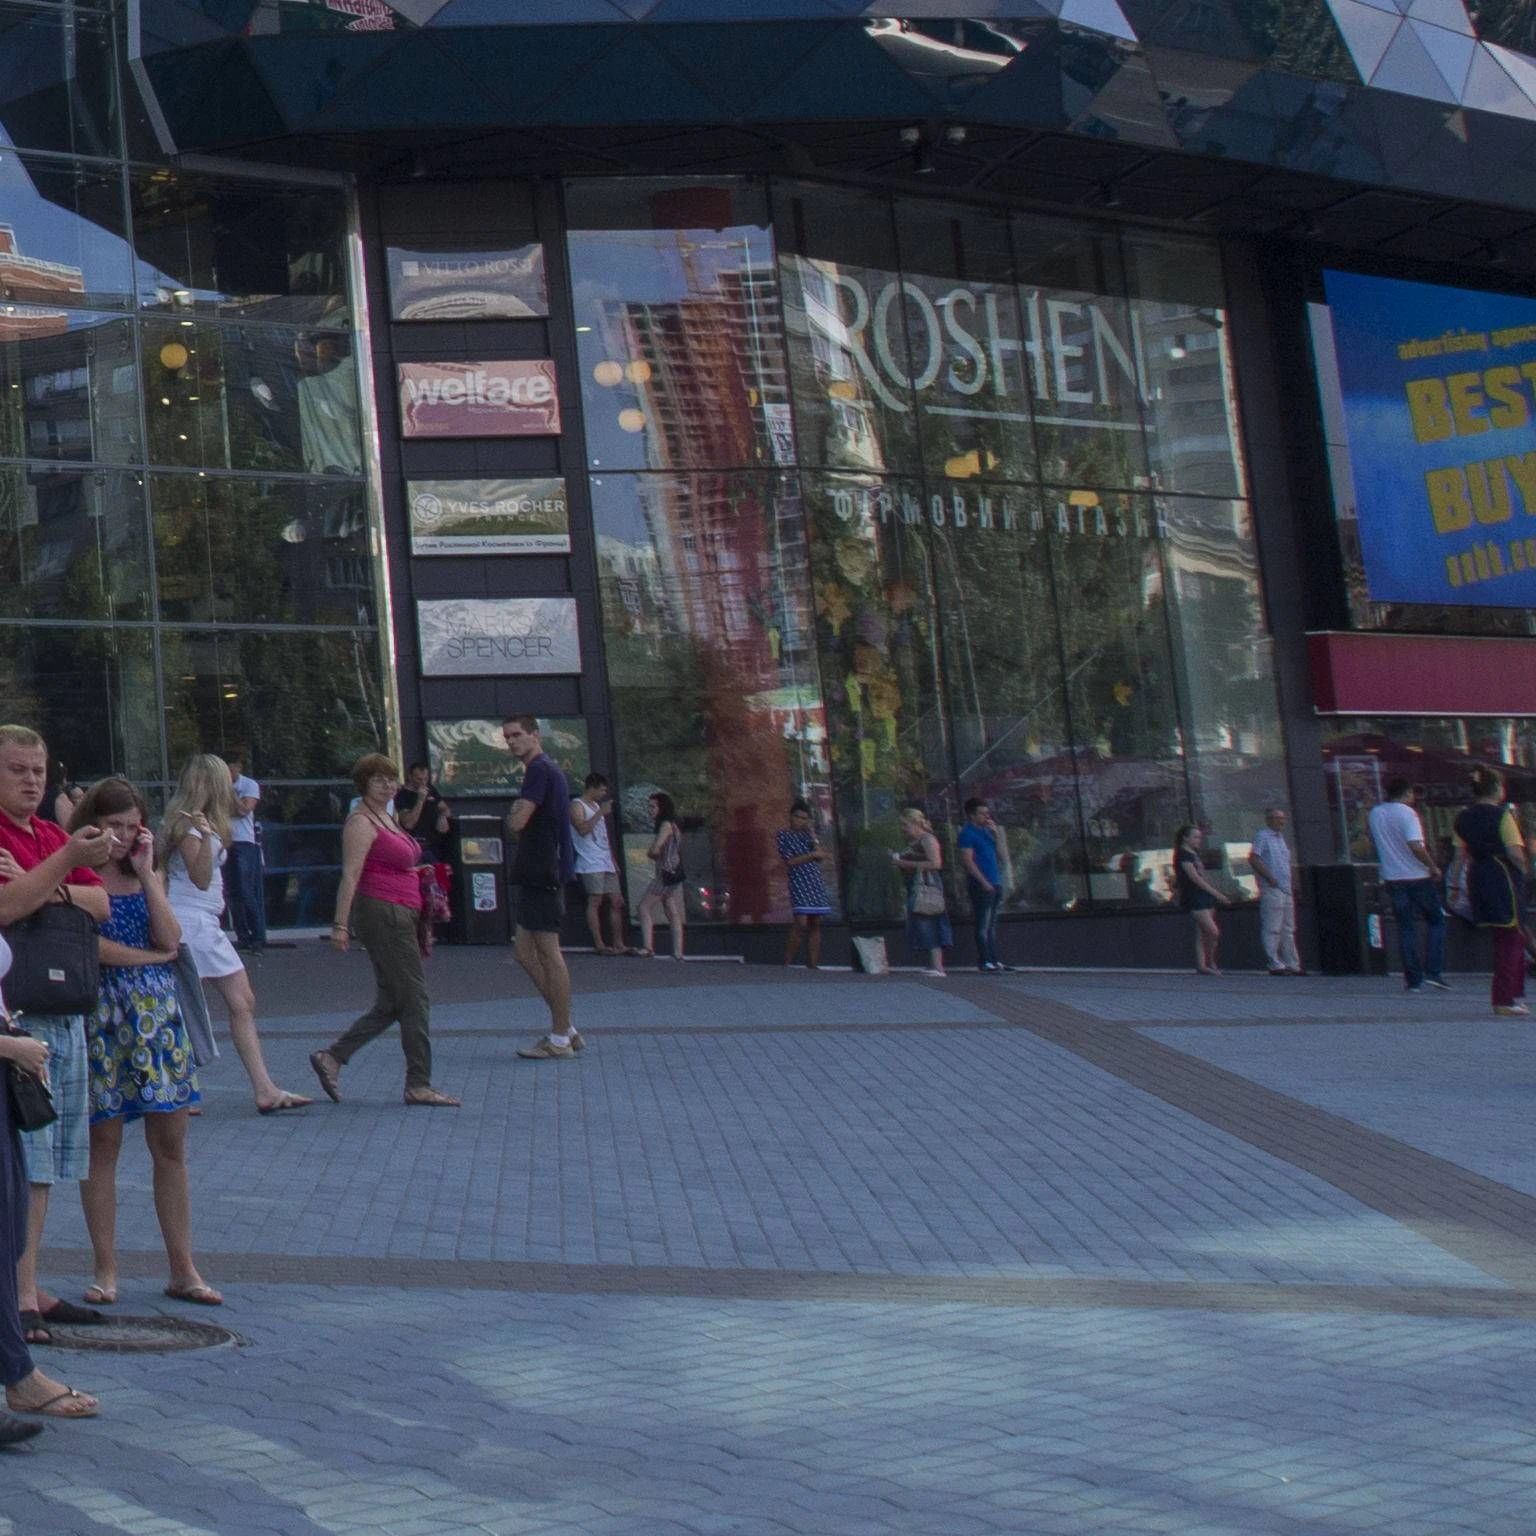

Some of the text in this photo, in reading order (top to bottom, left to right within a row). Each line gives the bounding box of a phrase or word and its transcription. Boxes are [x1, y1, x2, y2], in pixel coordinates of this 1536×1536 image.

[822, 272, 1151, 413] ROSHEN
[403, 370, 552, 406] welfare
[448, 499, 566, 514] YVES ROCHER
[446, 614, 533, 636] MARKS
[447, 636, 554, 659] SPENCER
